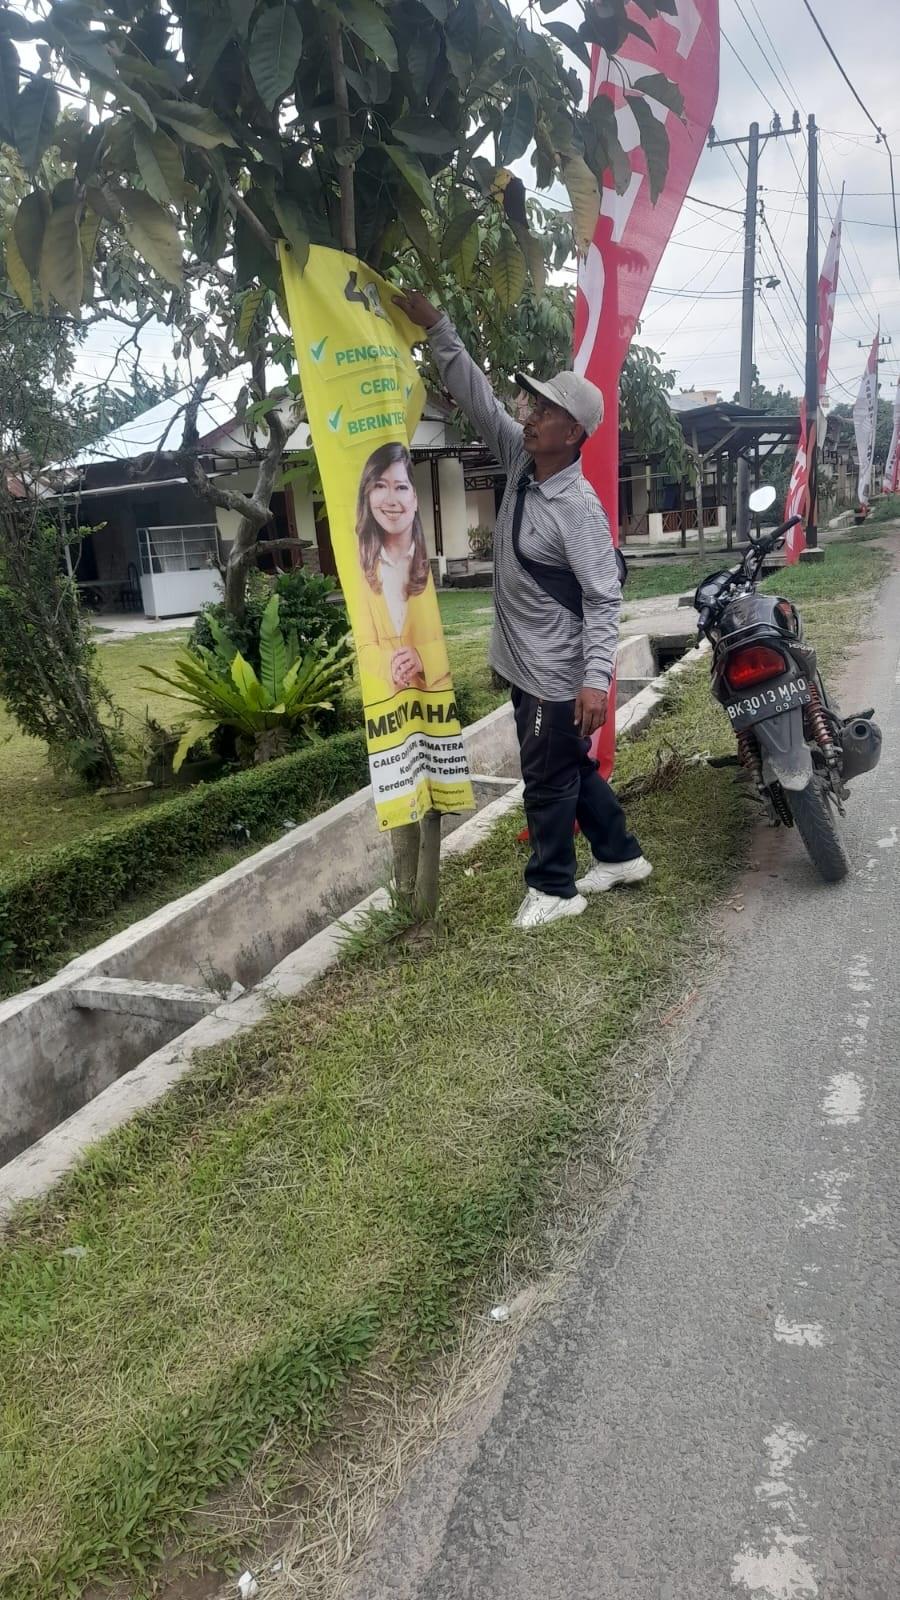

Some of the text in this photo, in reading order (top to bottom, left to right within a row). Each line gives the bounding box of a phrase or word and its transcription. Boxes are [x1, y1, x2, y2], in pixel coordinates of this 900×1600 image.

[727, 701, 744, 719] BK
[743, 690, 776, 712] 3013
[373, 754, 401, 769] CALEG
[378, 776, 414, 793] Serdang
[438, 765, 469, 775] Tebing
